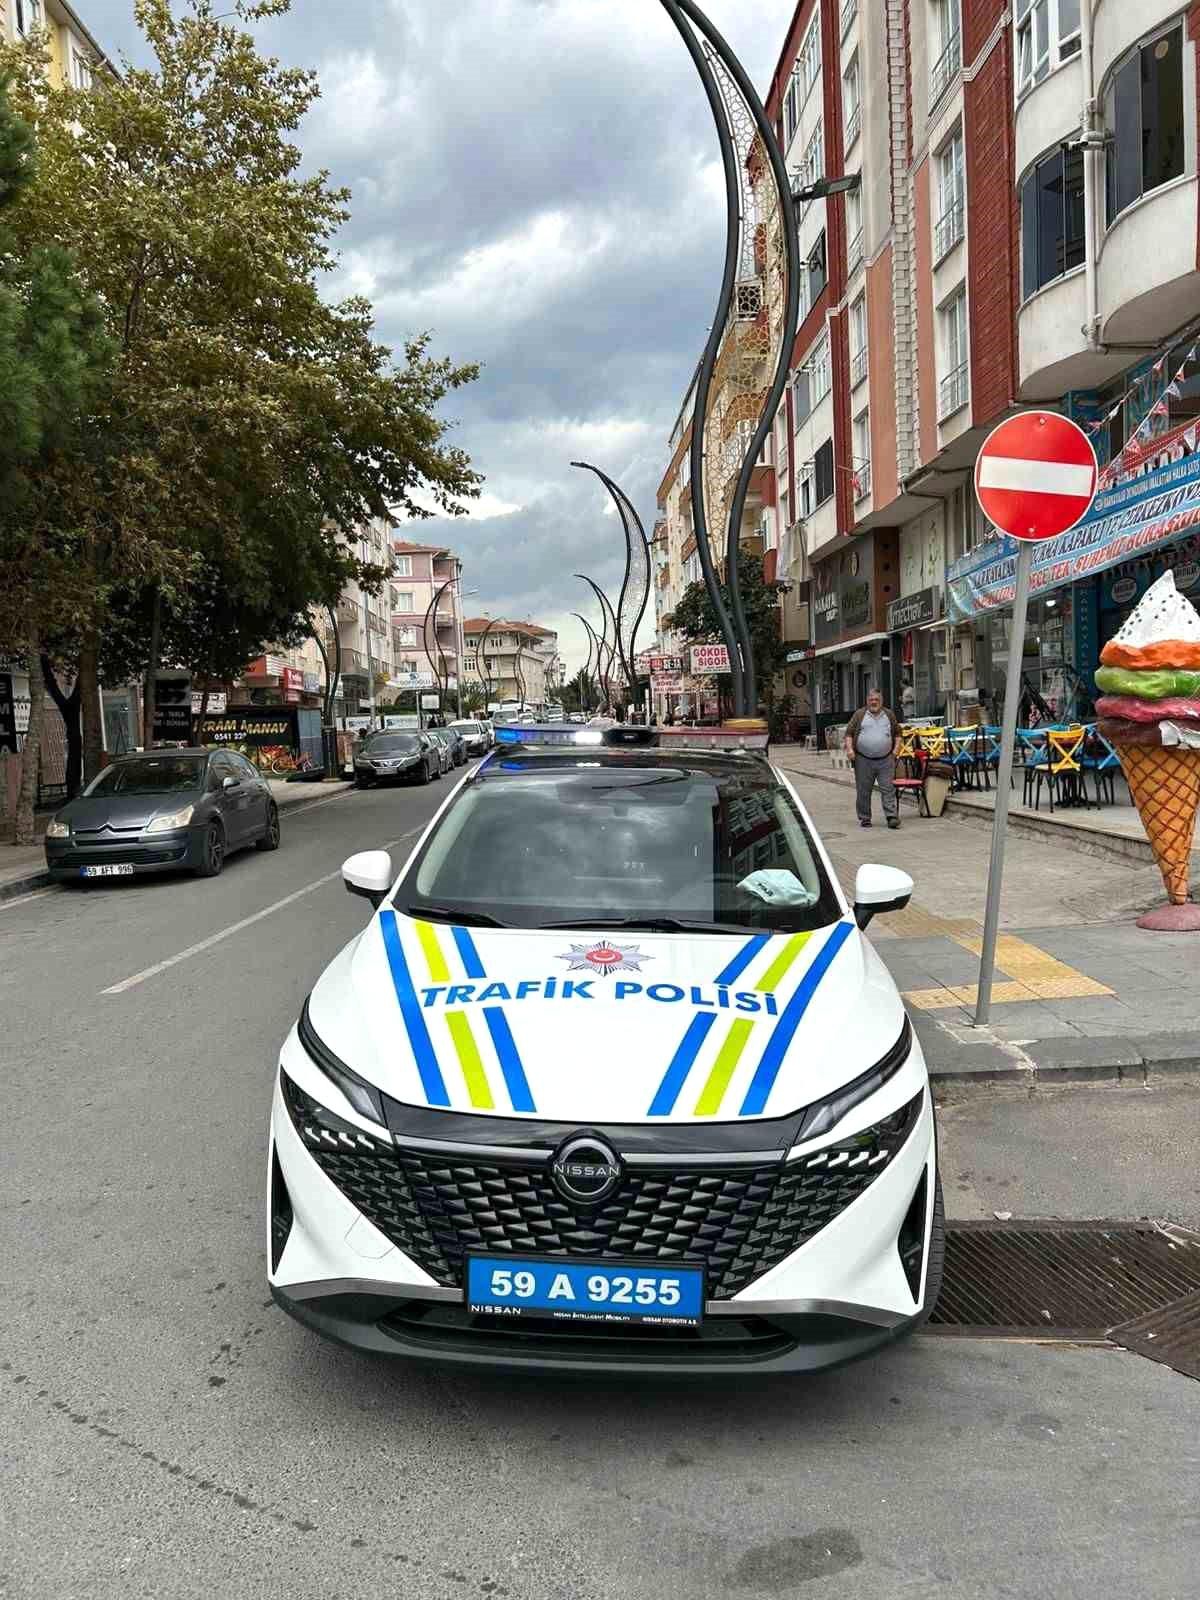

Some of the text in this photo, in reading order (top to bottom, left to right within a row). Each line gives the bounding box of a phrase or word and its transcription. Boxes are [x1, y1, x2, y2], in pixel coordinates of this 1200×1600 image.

[420, 976, 778, 1016] TRAFİK POLİSİ
[553, 1163, 620, 1177] NISSAN
[490, 1269, 681, 1306] 59 A 9255
[471, 1304, 522, 1315] NISSAN
